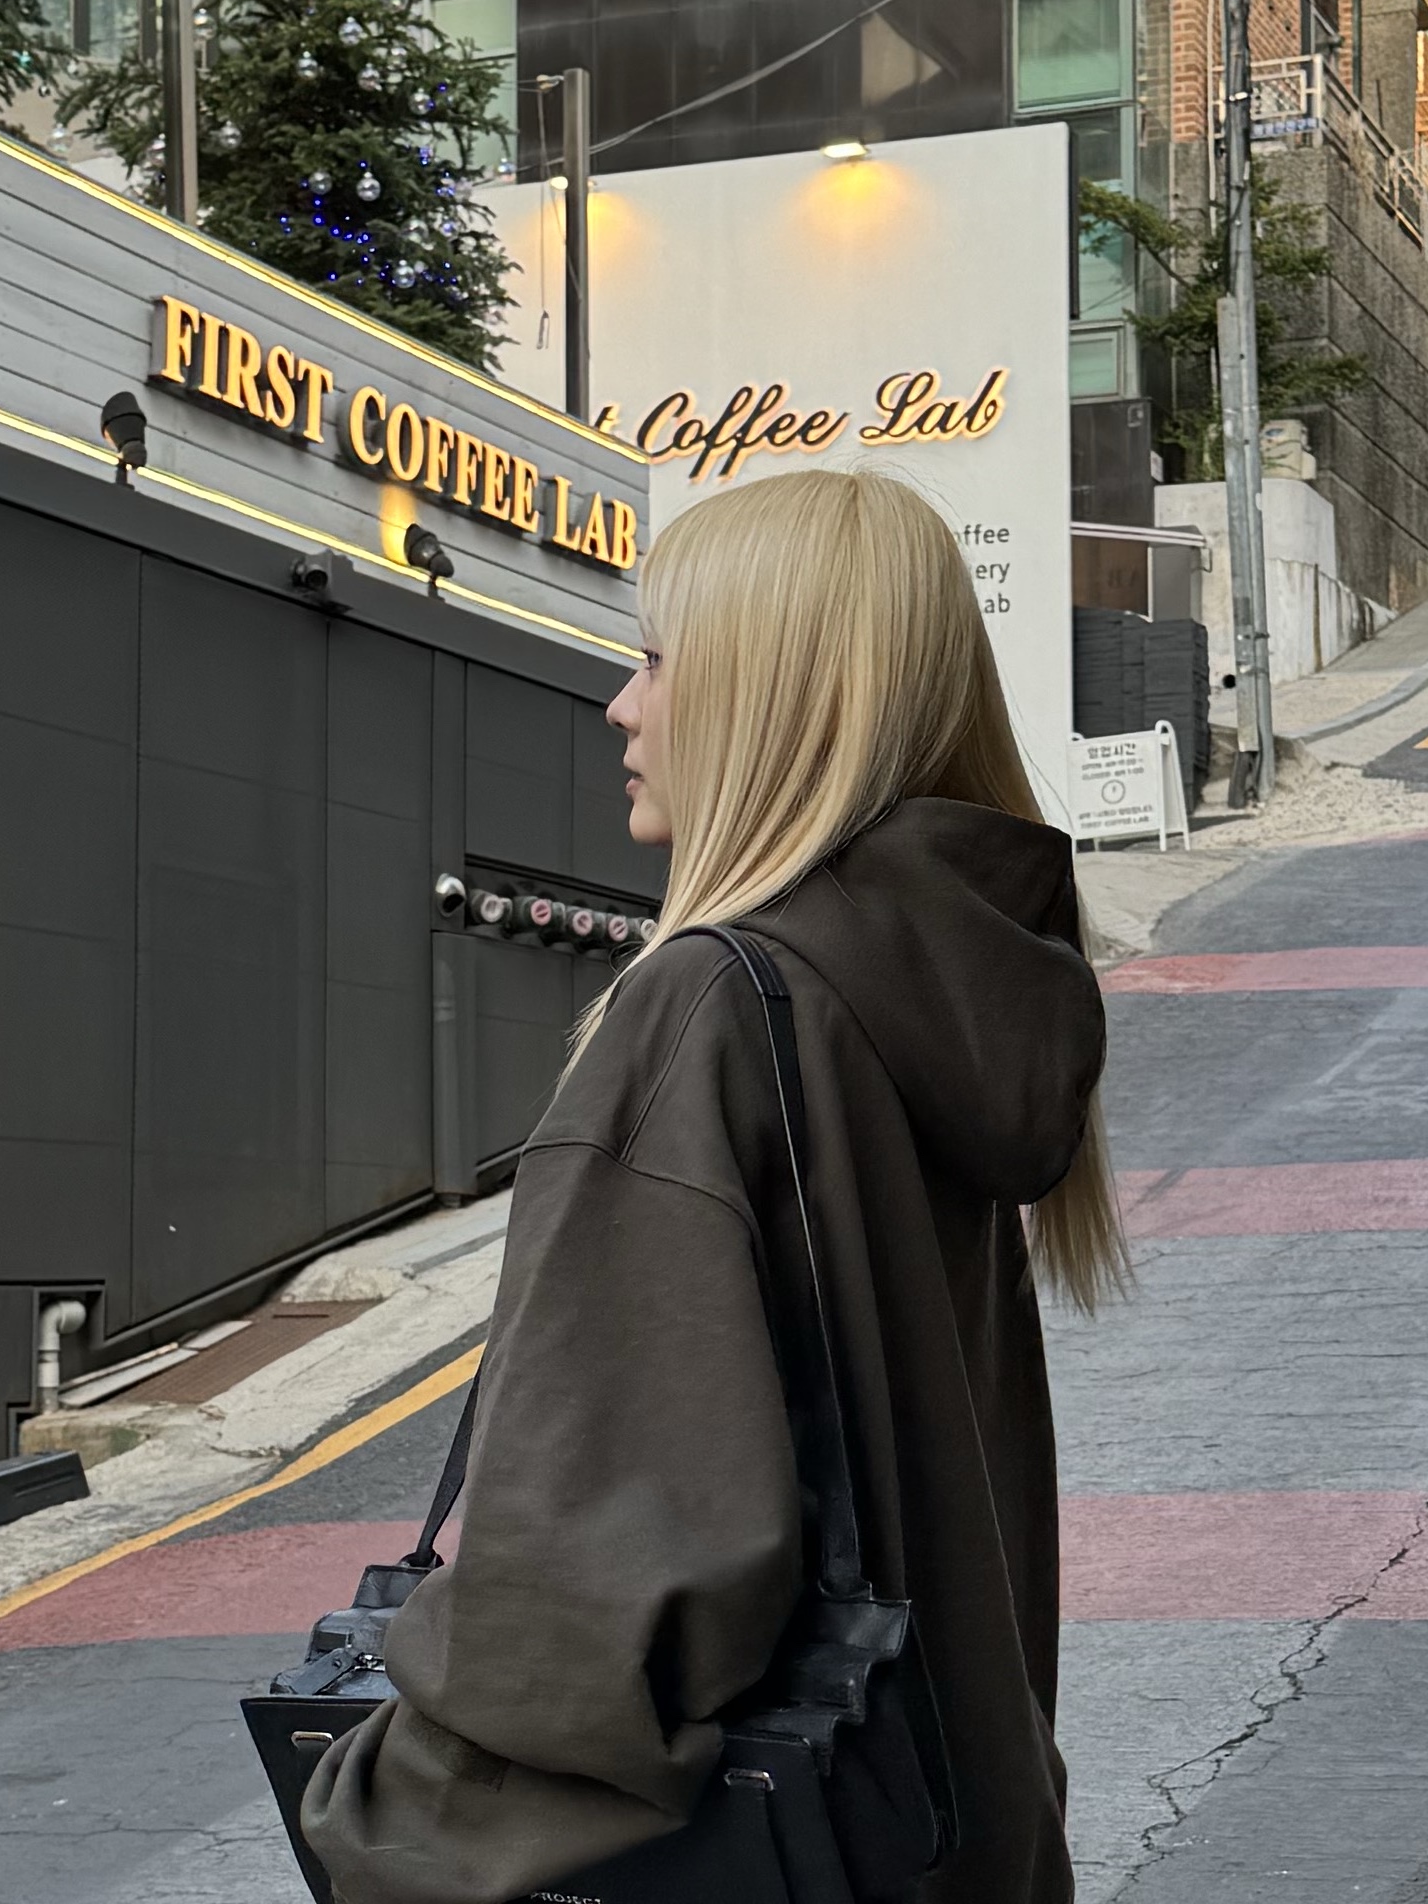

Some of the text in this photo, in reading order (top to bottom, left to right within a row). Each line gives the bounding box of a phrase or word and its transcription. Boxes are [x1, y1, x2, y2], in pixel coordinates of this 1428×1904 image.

[158, 295, 638, 571] FIRST COFFEE LAB
[636, 367, 1008, 480] Coffee Lab
[975, 562, 1011, 584] ery
[984, 591, 1011, 614] ab
